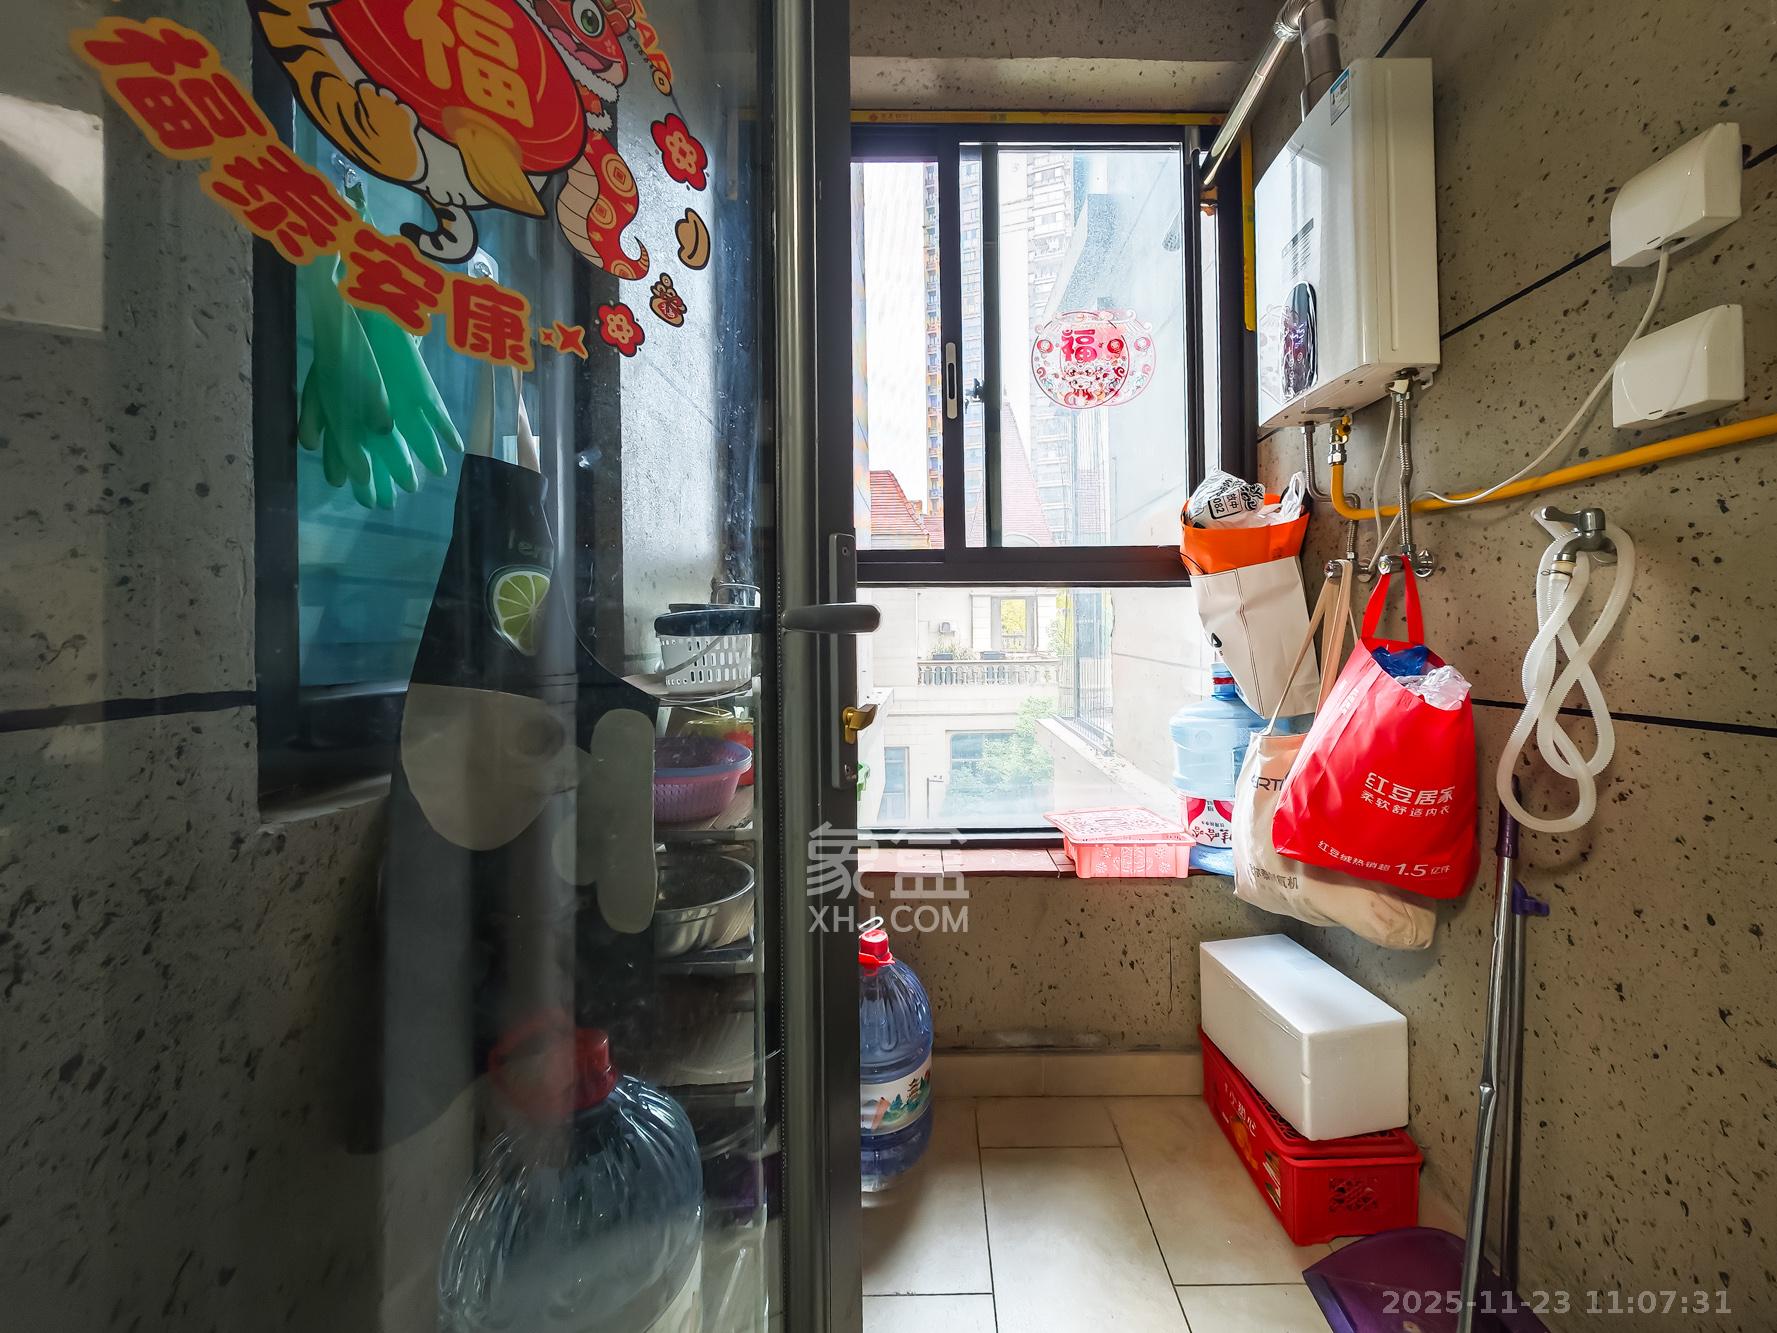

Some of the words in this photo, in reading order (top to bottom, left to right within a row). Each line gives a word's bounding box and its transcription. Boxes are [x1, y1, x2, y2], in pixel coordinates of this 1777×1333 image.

[404, 0, 534, 128] 福
[1061, 329, 1097, 362] 福
[1360, 790, 1450, 817] 柔软舒适内衣
[1365, 772, 1455, 805] 红豆居家
